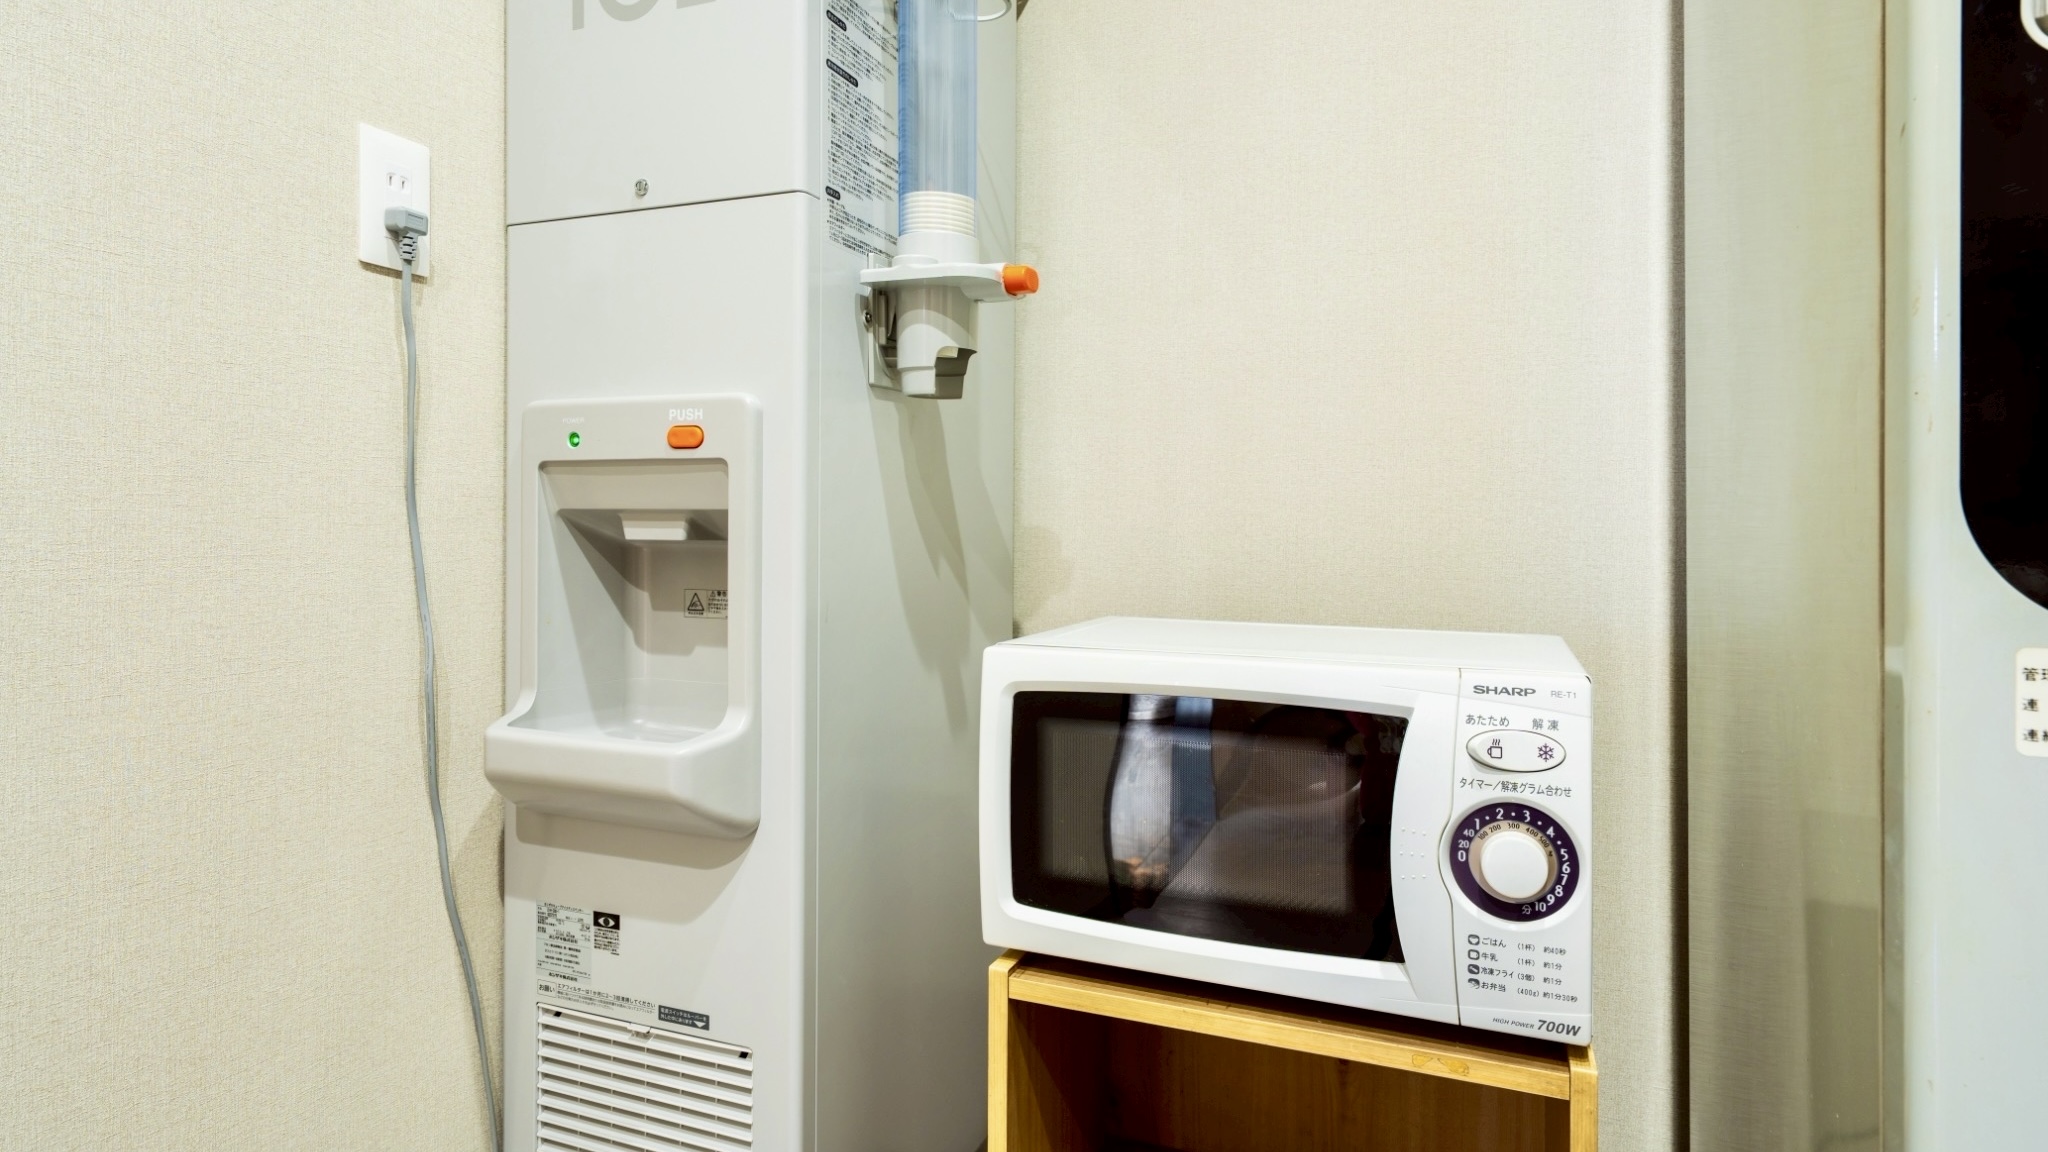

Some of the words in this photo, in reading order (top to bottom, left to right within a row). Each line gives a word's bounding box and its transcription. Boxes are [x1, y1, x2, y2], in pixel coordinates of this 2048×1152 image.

[669, 408, 704, 421] PUSH
[1473, 685, 1536, 697] SHARP
[1550, 690, 1577, 699] RE-T1
[1465, 714, 1510, 727] あたため
[1495, 808, 1504, 820] 2
[1523, 810, 1531, 823] 3
[1474, 818, 1480, 830] 1
[1463, 828, 1475, 838] 40
[1478, 830, 1489, 841] 100
[1488, 824, 1502, 833] 200
[1507, 822, 1520, 830] 300
[1525, 827, 1539, 838] 400
[1546, 826, 1556, 838] 4
[1458, 840, 1470, 848] 20
[1457, 849, 1467, 862] 0
[1560, 848, 1569, 860] 5
[1562, 862, 1571, 873] 6
[1560, 873, 1569, 885] 7
[1554, 885, 1564, 897] 8
[1546, 894, 1556, 905] 9
[1521, 904, 1532, 914] 分
[1534, 901, 1547, 913] 10
[1482, 937, 1507, 948] ごはん
[1481, 952, 1498, 962] 牛乳
[1543, 961, 1563, 971] 約1分
[1480, 966, 1514, 979] 冷凍フライ
[1543, 976, 1563, 986] 約1分
[1480, 981, 1506, 993] お弁当
[1492, 1017, 1510, 1025] HIGH
[1510, 1020, 1535, 1029] POWER
[1537, 1019, 1581, 1037] 700W
